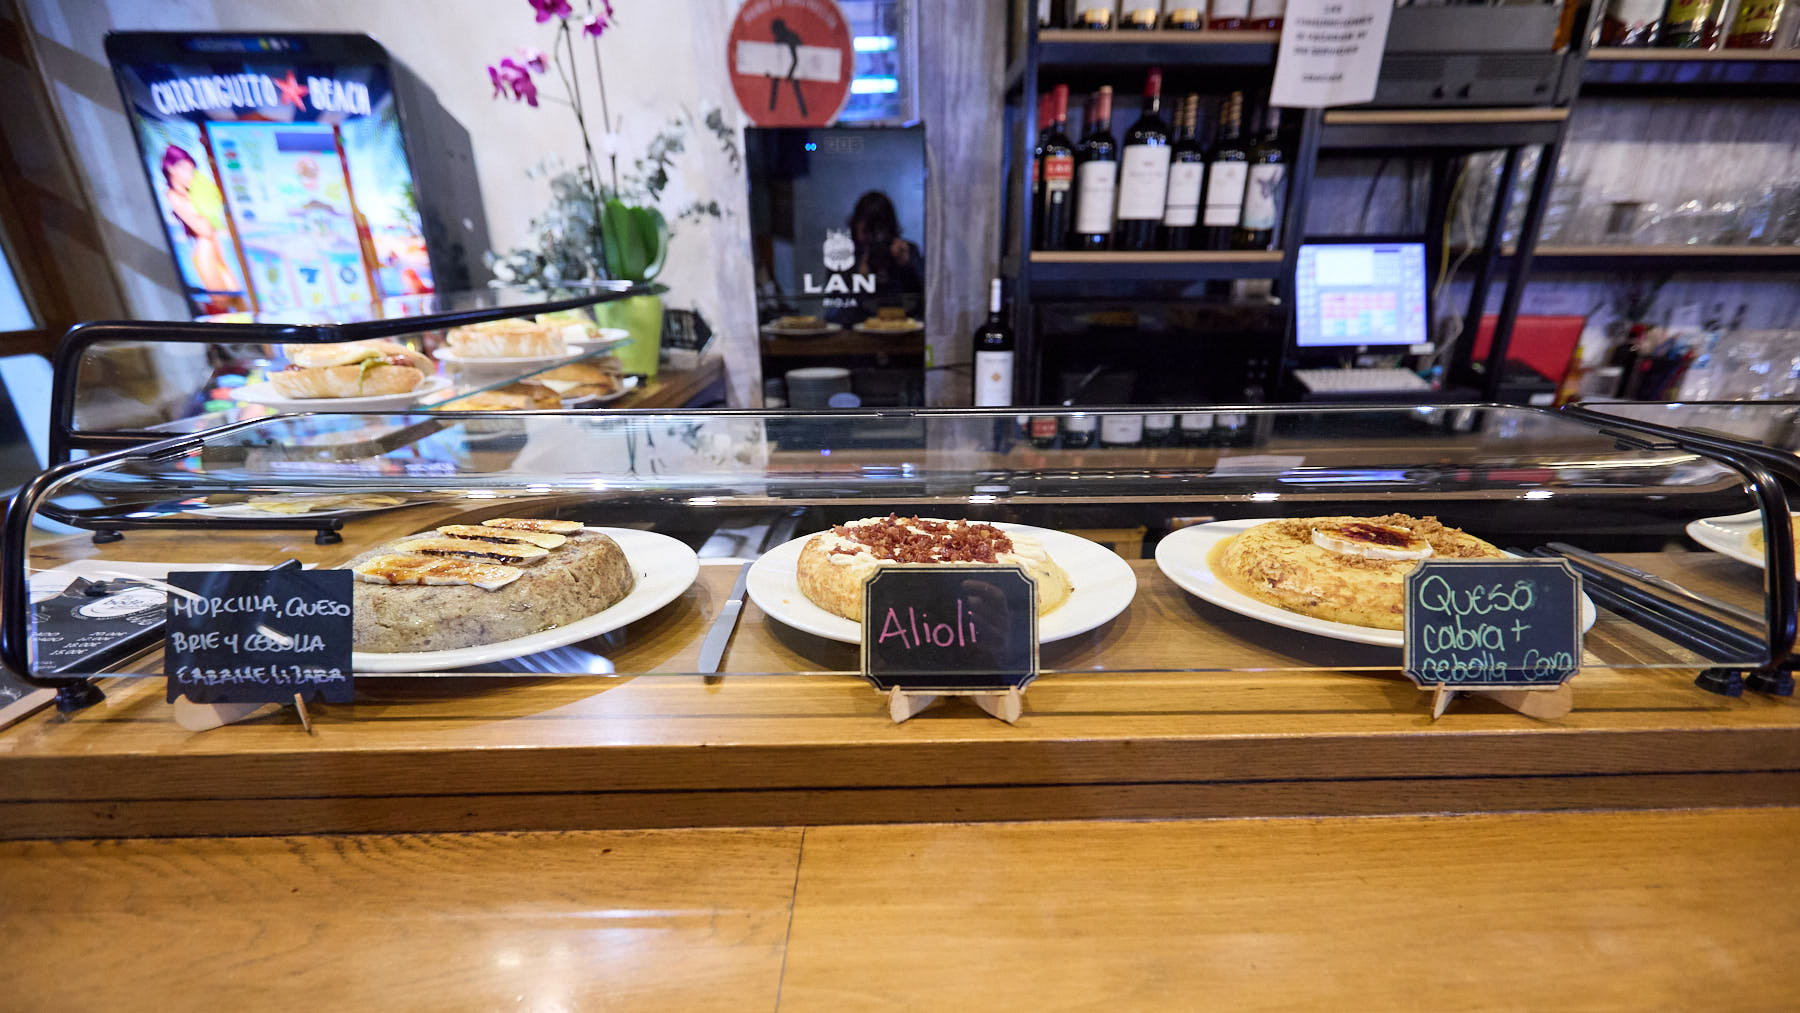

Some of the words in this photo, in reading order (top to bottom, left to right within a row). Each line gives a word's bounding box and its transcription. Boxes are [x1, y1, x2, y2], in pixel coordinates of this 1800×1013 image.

[150, 74, 278, 115] CHIRINGUITO
[306, 76, 371, 115] BEACH
[803, 273, 876, 294] LAN
[174, 595, 282, 618] MORCILLA,
[285, 597, 351, 617] QUESO
[878, 599, 977, 649] Alioli
[172, 631, 220, 653] BRIE
[1422, 650, 1507, 682] cebolla
